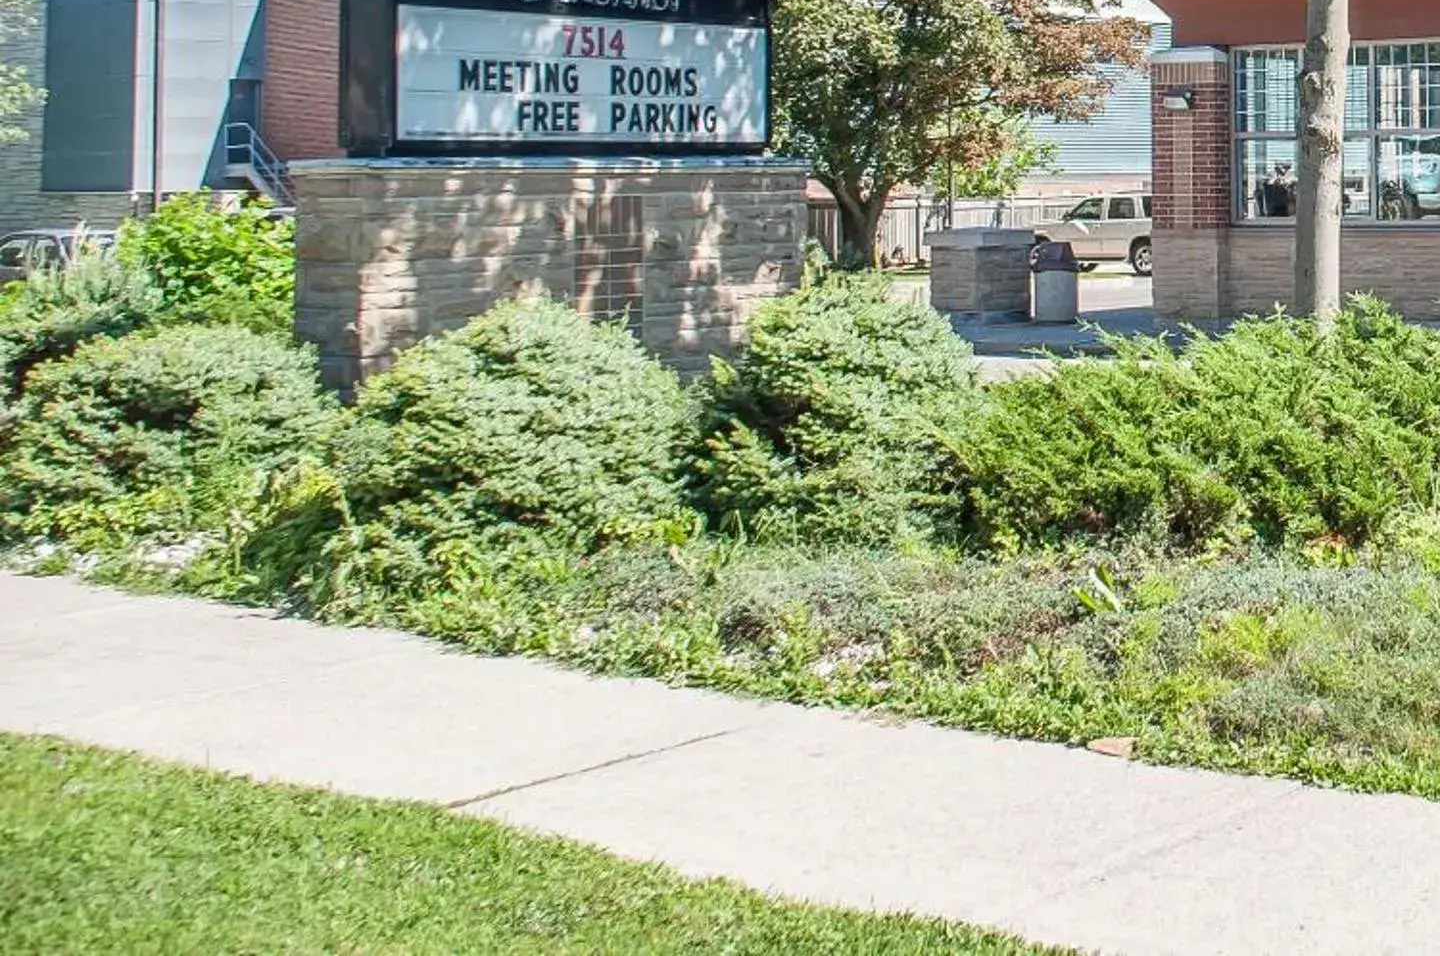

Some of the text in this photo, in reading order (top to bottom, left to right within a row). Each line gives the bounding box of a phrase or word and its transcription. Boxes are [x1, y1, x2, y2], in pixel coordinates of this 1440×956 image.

[564, 26, 625, 57] 7514
[459, 59, 697, 97] MEETING ROOMS
[518, 101, 717, 133] FREE PARKING
